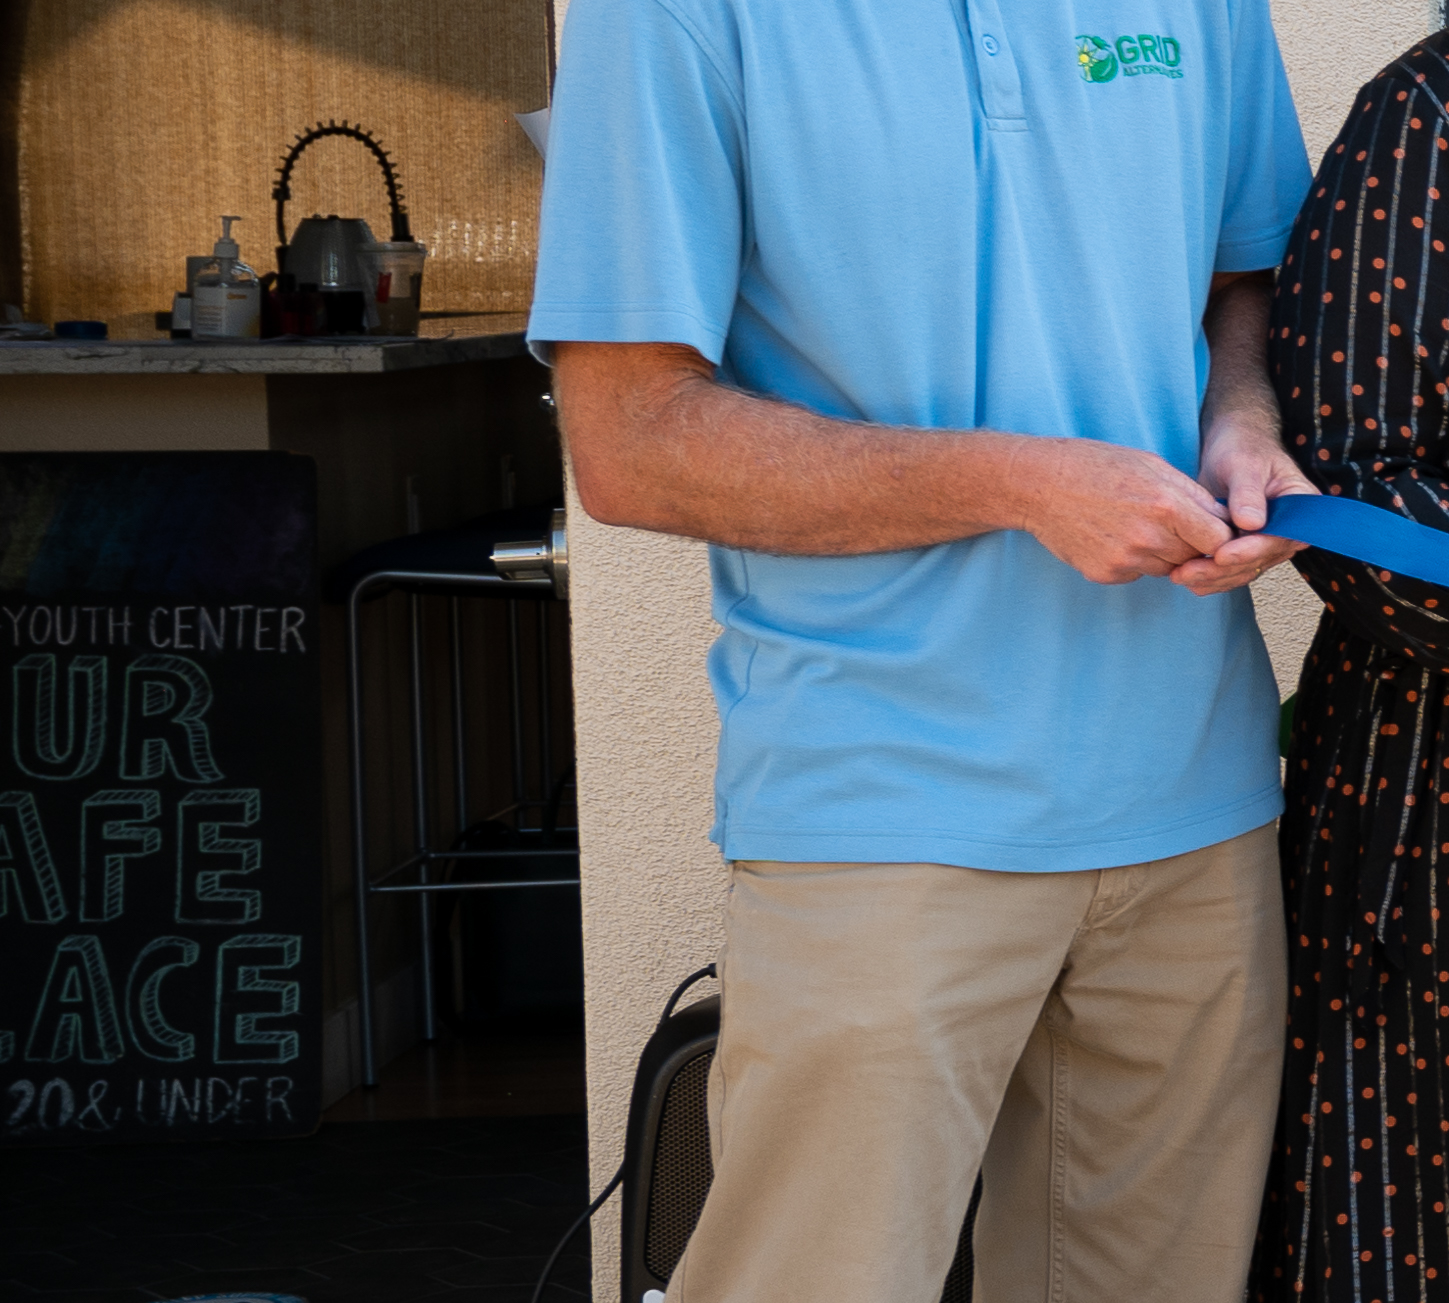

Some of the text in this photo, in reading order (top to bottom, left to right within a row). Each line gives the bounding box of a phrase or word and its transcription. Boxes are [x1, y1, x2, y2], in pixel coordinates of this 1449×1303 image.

[1116, 34, 1180, 68] GRID
[2, 604, 306, 653] YOUTH CENTER
[0, 933, 303, 1065] ACE
[137, 1076, 294, 1127] UNDER
